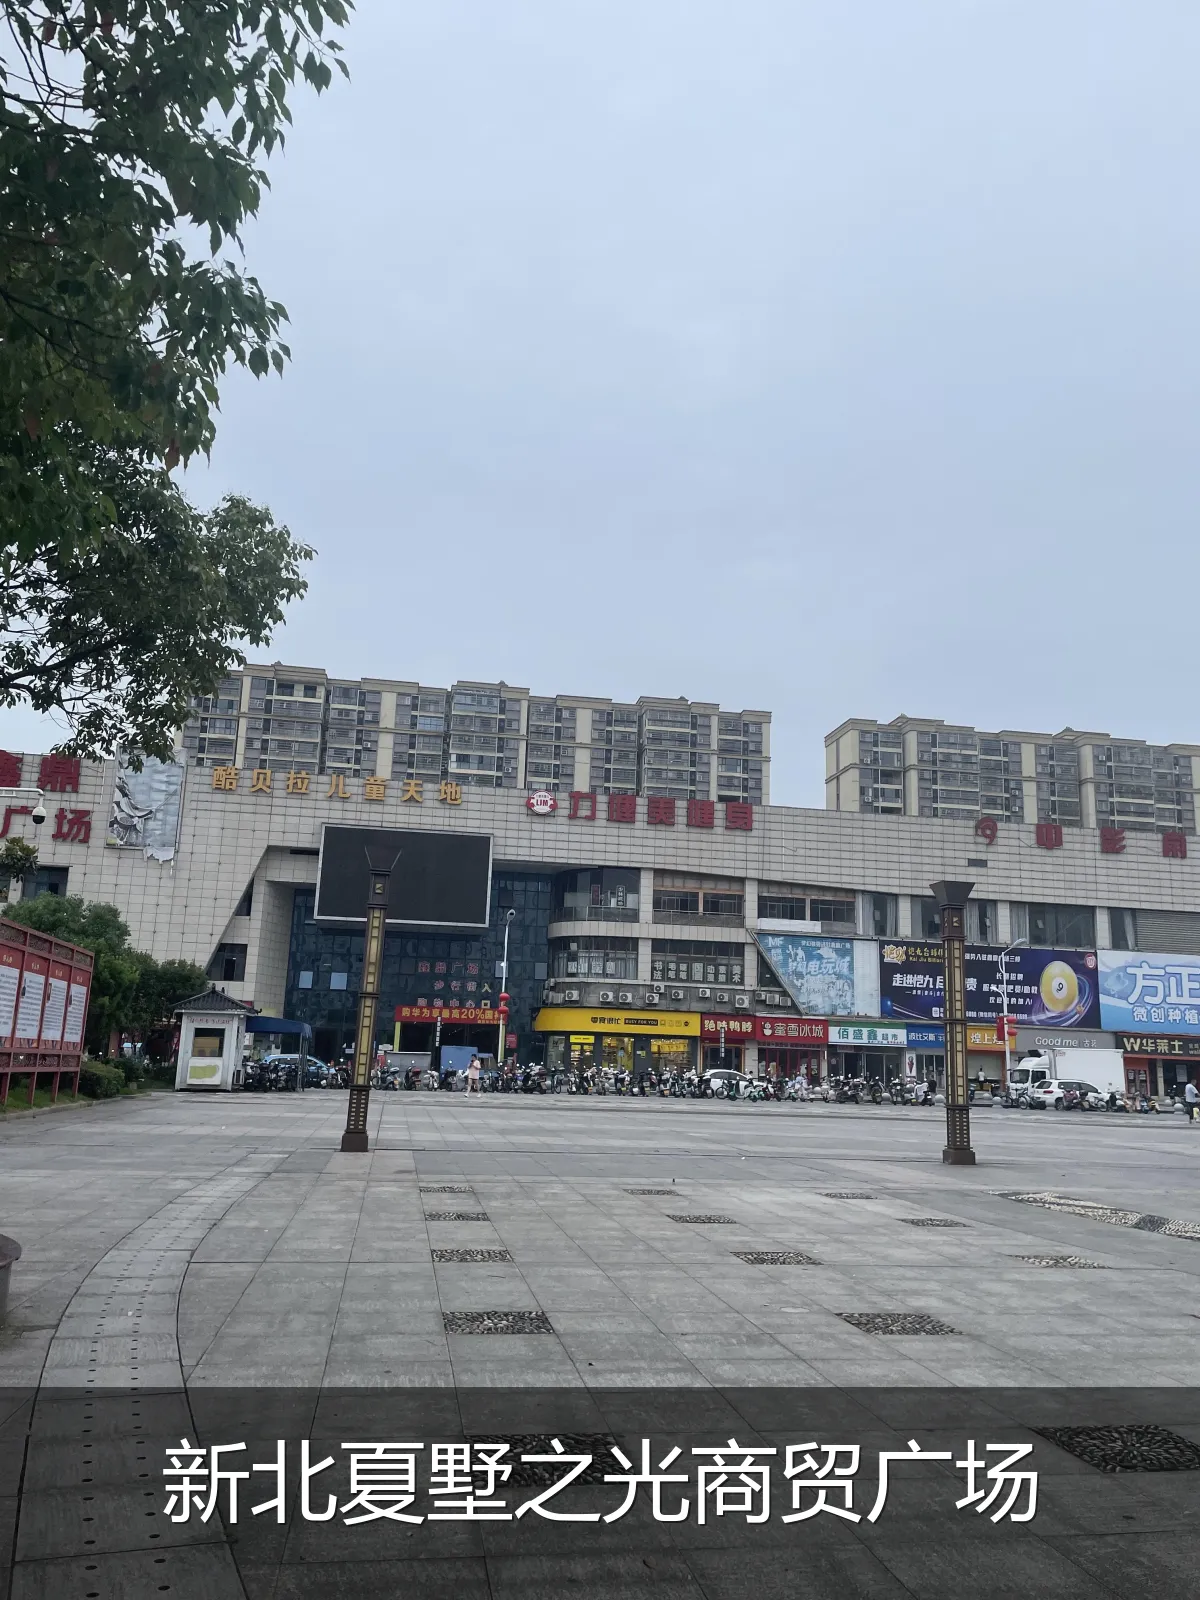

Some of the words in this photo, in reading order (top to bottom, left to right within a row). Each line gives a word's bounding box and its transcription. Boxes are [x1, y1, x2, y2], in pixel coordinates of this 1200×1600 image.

[212, 766, 462, 805] 酷贝拉儿童天地
[653, 960, 663, 980] 书法
[732, 965, 742, 983] 美术
[1126, 961, 1200, 1004] 方正
[1133, 1006, 1199, 1024] 微创种植
[704, 1019, 752, 1033] 绝味鸭脖
[774, 1022, 824, 1038] 蜜雪冰城
[1035, 1036, 1061, 1046] Good
[1063, 1038, 1078, 1047] me
